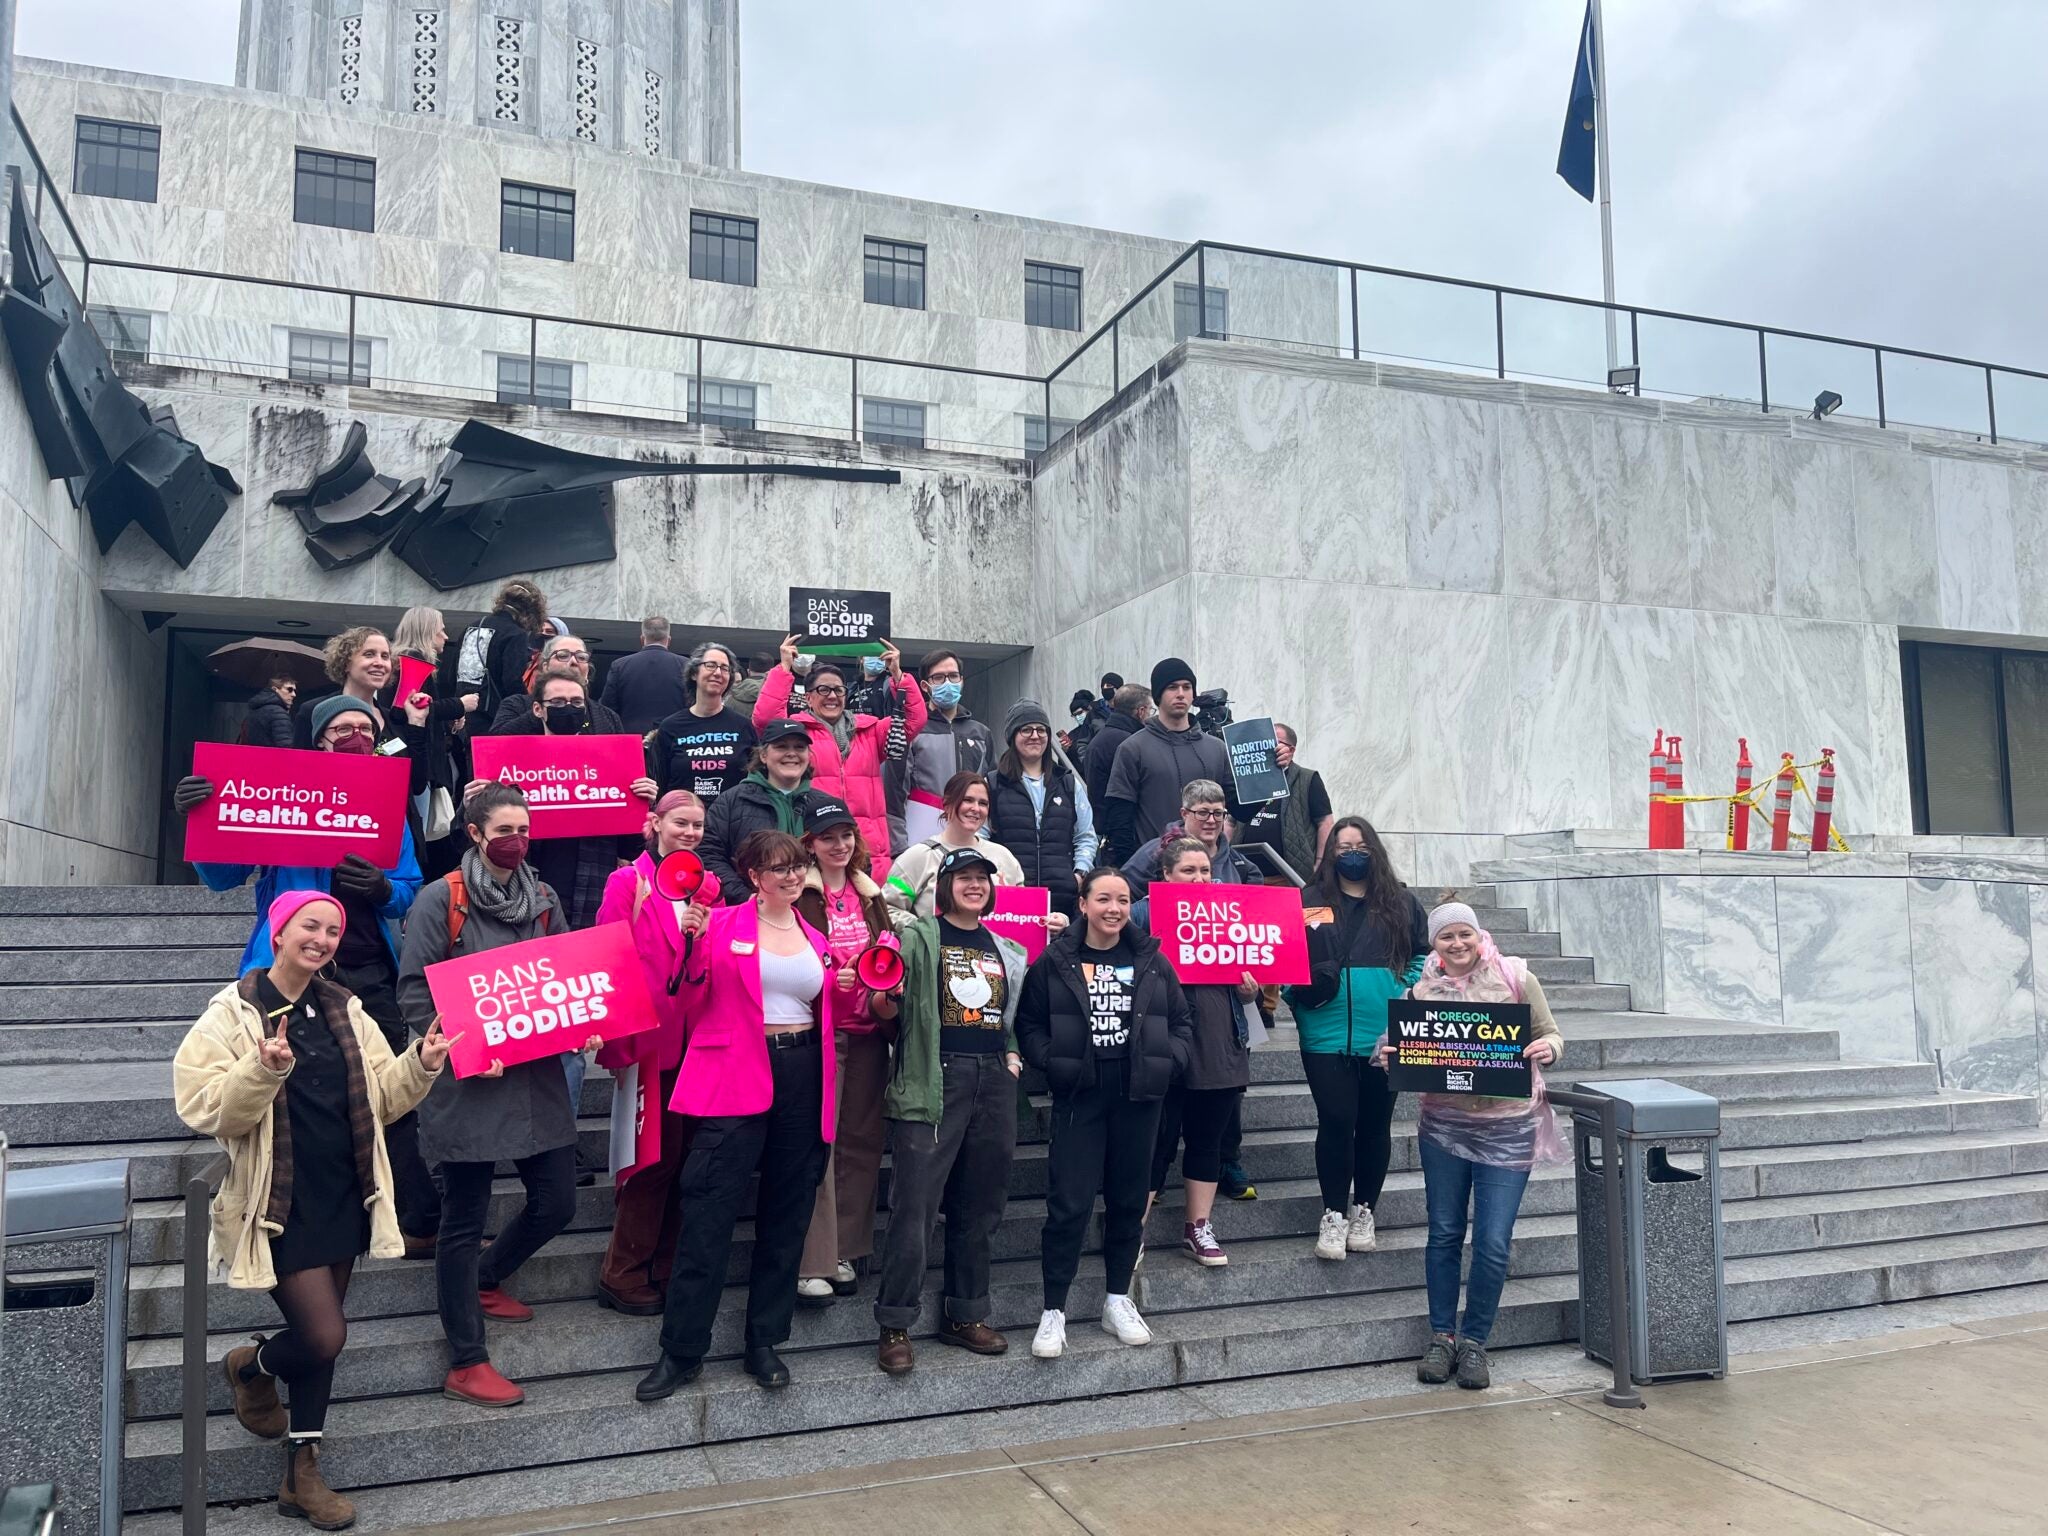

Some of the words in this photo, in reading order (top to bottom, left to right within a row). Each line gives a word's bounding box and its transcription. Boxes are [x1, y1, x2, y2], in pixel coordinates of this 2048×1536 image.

[808, 598, 849, 612] BANS
[807, 611, 838, 624] OFF
[839, 612, 874, 626] OUR
[808, 623, 868, 638] BODIES
[677, 732, 739, 745] PROTECT
[686, 746, 734, 757] TRANS
[1231, 739, 1276, 755] ABORTION
[691, 760, 727, 771] KIDS
[1233, 751, 1267, 766] ACCESS
[498, 765, 579, 782] Abortion
[583, 764, 598, 781] is
[1235, 765, 1252, 777] FOR
[1253, 762, 1271, 775] ALL.
[219, 779, 324, 804] Abortion
[331, 786, 348, 805] is
[520, 784, 570, 802] ealth
[574, 784, 626, 800] Care.
[218, 803, 308, 827] Health
[315, 808, 379, 830] Care.
[978, 911, 1040, 926] forRepro
[1176, 901, 1242, 922] BANS
[1176, 922, 1225, 943] OFF
[1228, 923, 1284, 945] OUR
[1179, 944, 1275, 966] BODIES
[468, 957, 556, 998] BANS
[1087, 980, 1122, 994] OUR
[475, 986, 538, 1020] OFF
[541, 971, 615, 1005] OUR
[1089, 995, 1132, 1011] TURE
[483, 996, 609, 1047] BODIES
[1089, 1016, 1122, 1031] OUR
[1425, 1010, 1438, 1021] IN
[1438, 1011, 1493, 1024] OREGON,
[1399, 1021, 1429, 1037] WE
[1433, 1022, 1473, 1039] SAY
[1477, 1024, 1521, 1041] GAY
